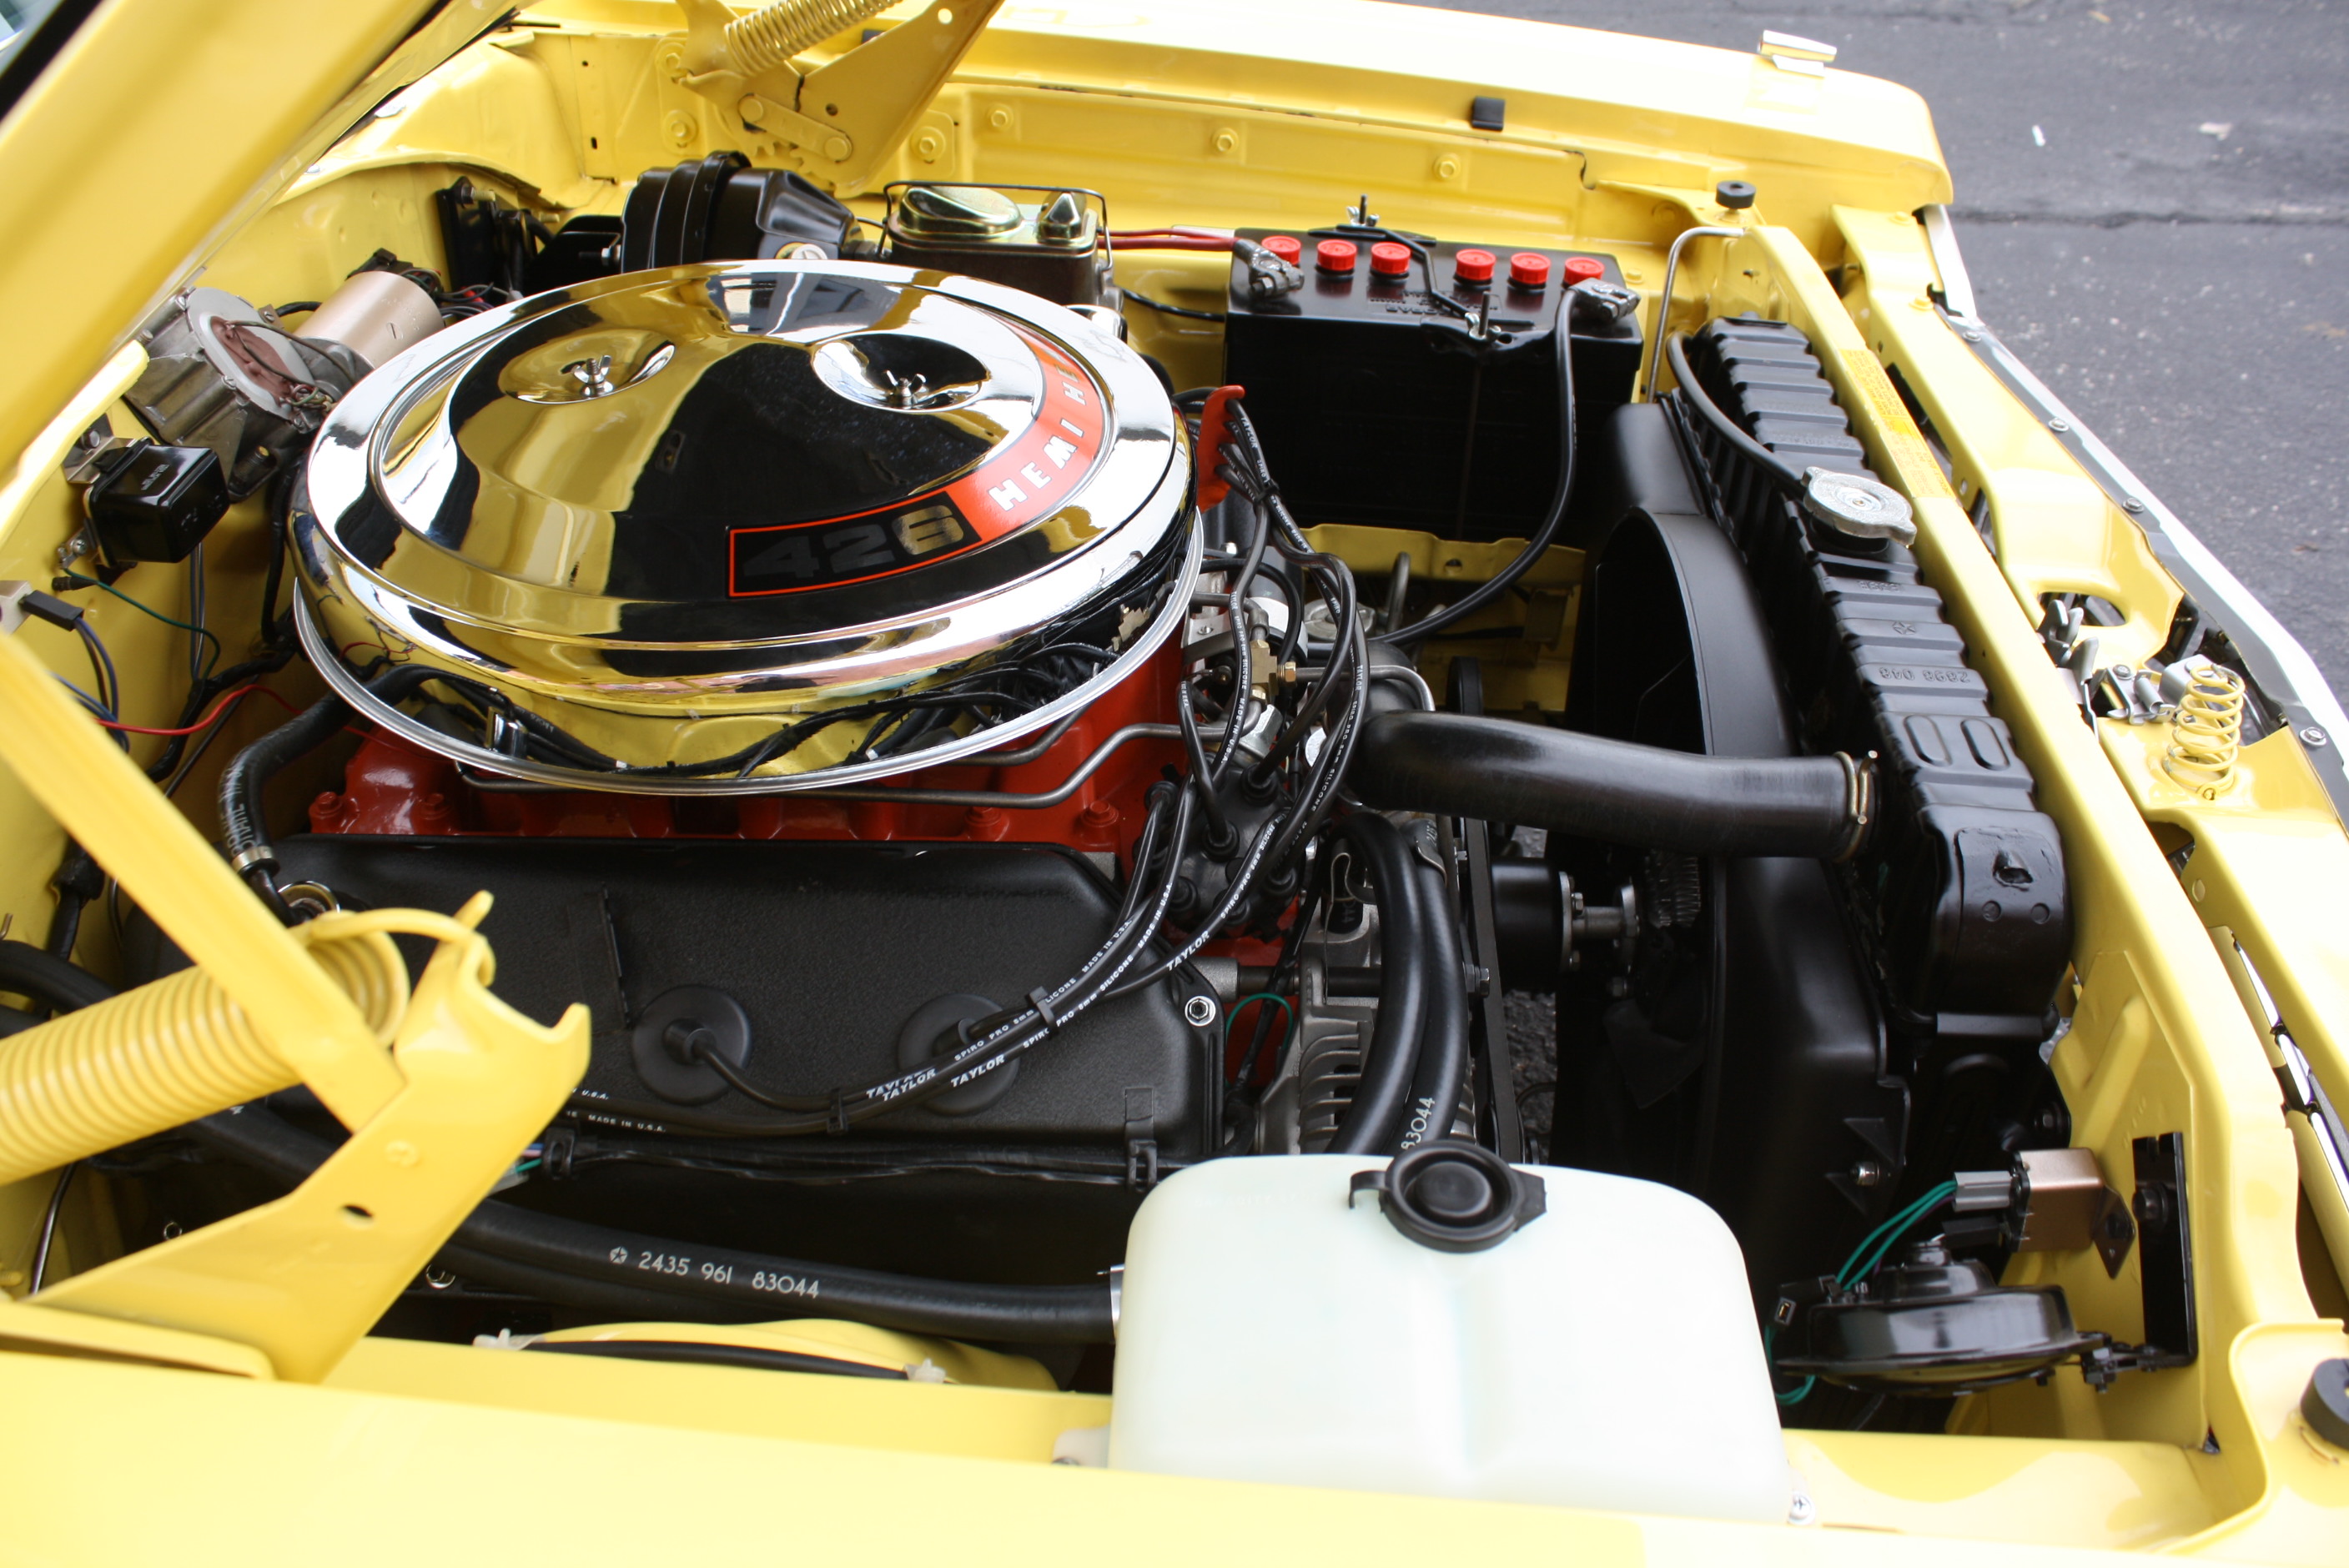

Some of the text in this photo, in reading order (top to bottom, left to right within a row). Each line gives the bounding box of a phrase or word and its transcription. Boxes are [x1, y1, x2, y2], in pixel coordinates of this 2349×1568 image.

[742, 418, 1084, 579] 426 HEMI
[1355, 665, 1363, 691] TAYLOR
[1236, 698, 1245, 721] MADE
[1233, 724, 1240, 735] IN
[1221, 739, 1235, 764] U.S.A.
[1311, 768, 1335, 812] SILICONE
[1166, 930, 1210, 972] TAYLOR
[1220, 893, 1240, 919] SPIRO
[1240, 872, 1251, 891] PRO
[950, 1054, 1005, 1088] TAYLOR
[1056, 1011, 1075, 1028] PRO
[1078, 993, 1098, 1011] 8mm
[1099, 954, 1134, 992] SILICONE
[1137, 922, 1156, 949] MADE
[1154, 909, 1162, 921] IN
[1159, 882, 1173, 907] U.S.A.
[882, 1068, 938, 1102] TAYLOR
[953, 1039, 985, 1062] SPIRO
[988, 1024, 1009, 1040] PRO
[1044, 977, 1077, 1003] LICONE
[1081, 952, 1104, 973] MADE
[1103, 941, 1114, 950] IN
[1113, 919, 1133, 939] U.S.A.
[581, 1089, 609, 1100] U.S.A.
[588, 1114, 616, 1125] MADE
[637, 1123, 666, 1133] U.S.A.
[638, 1251, 820, 1299] 2435 961 83044
